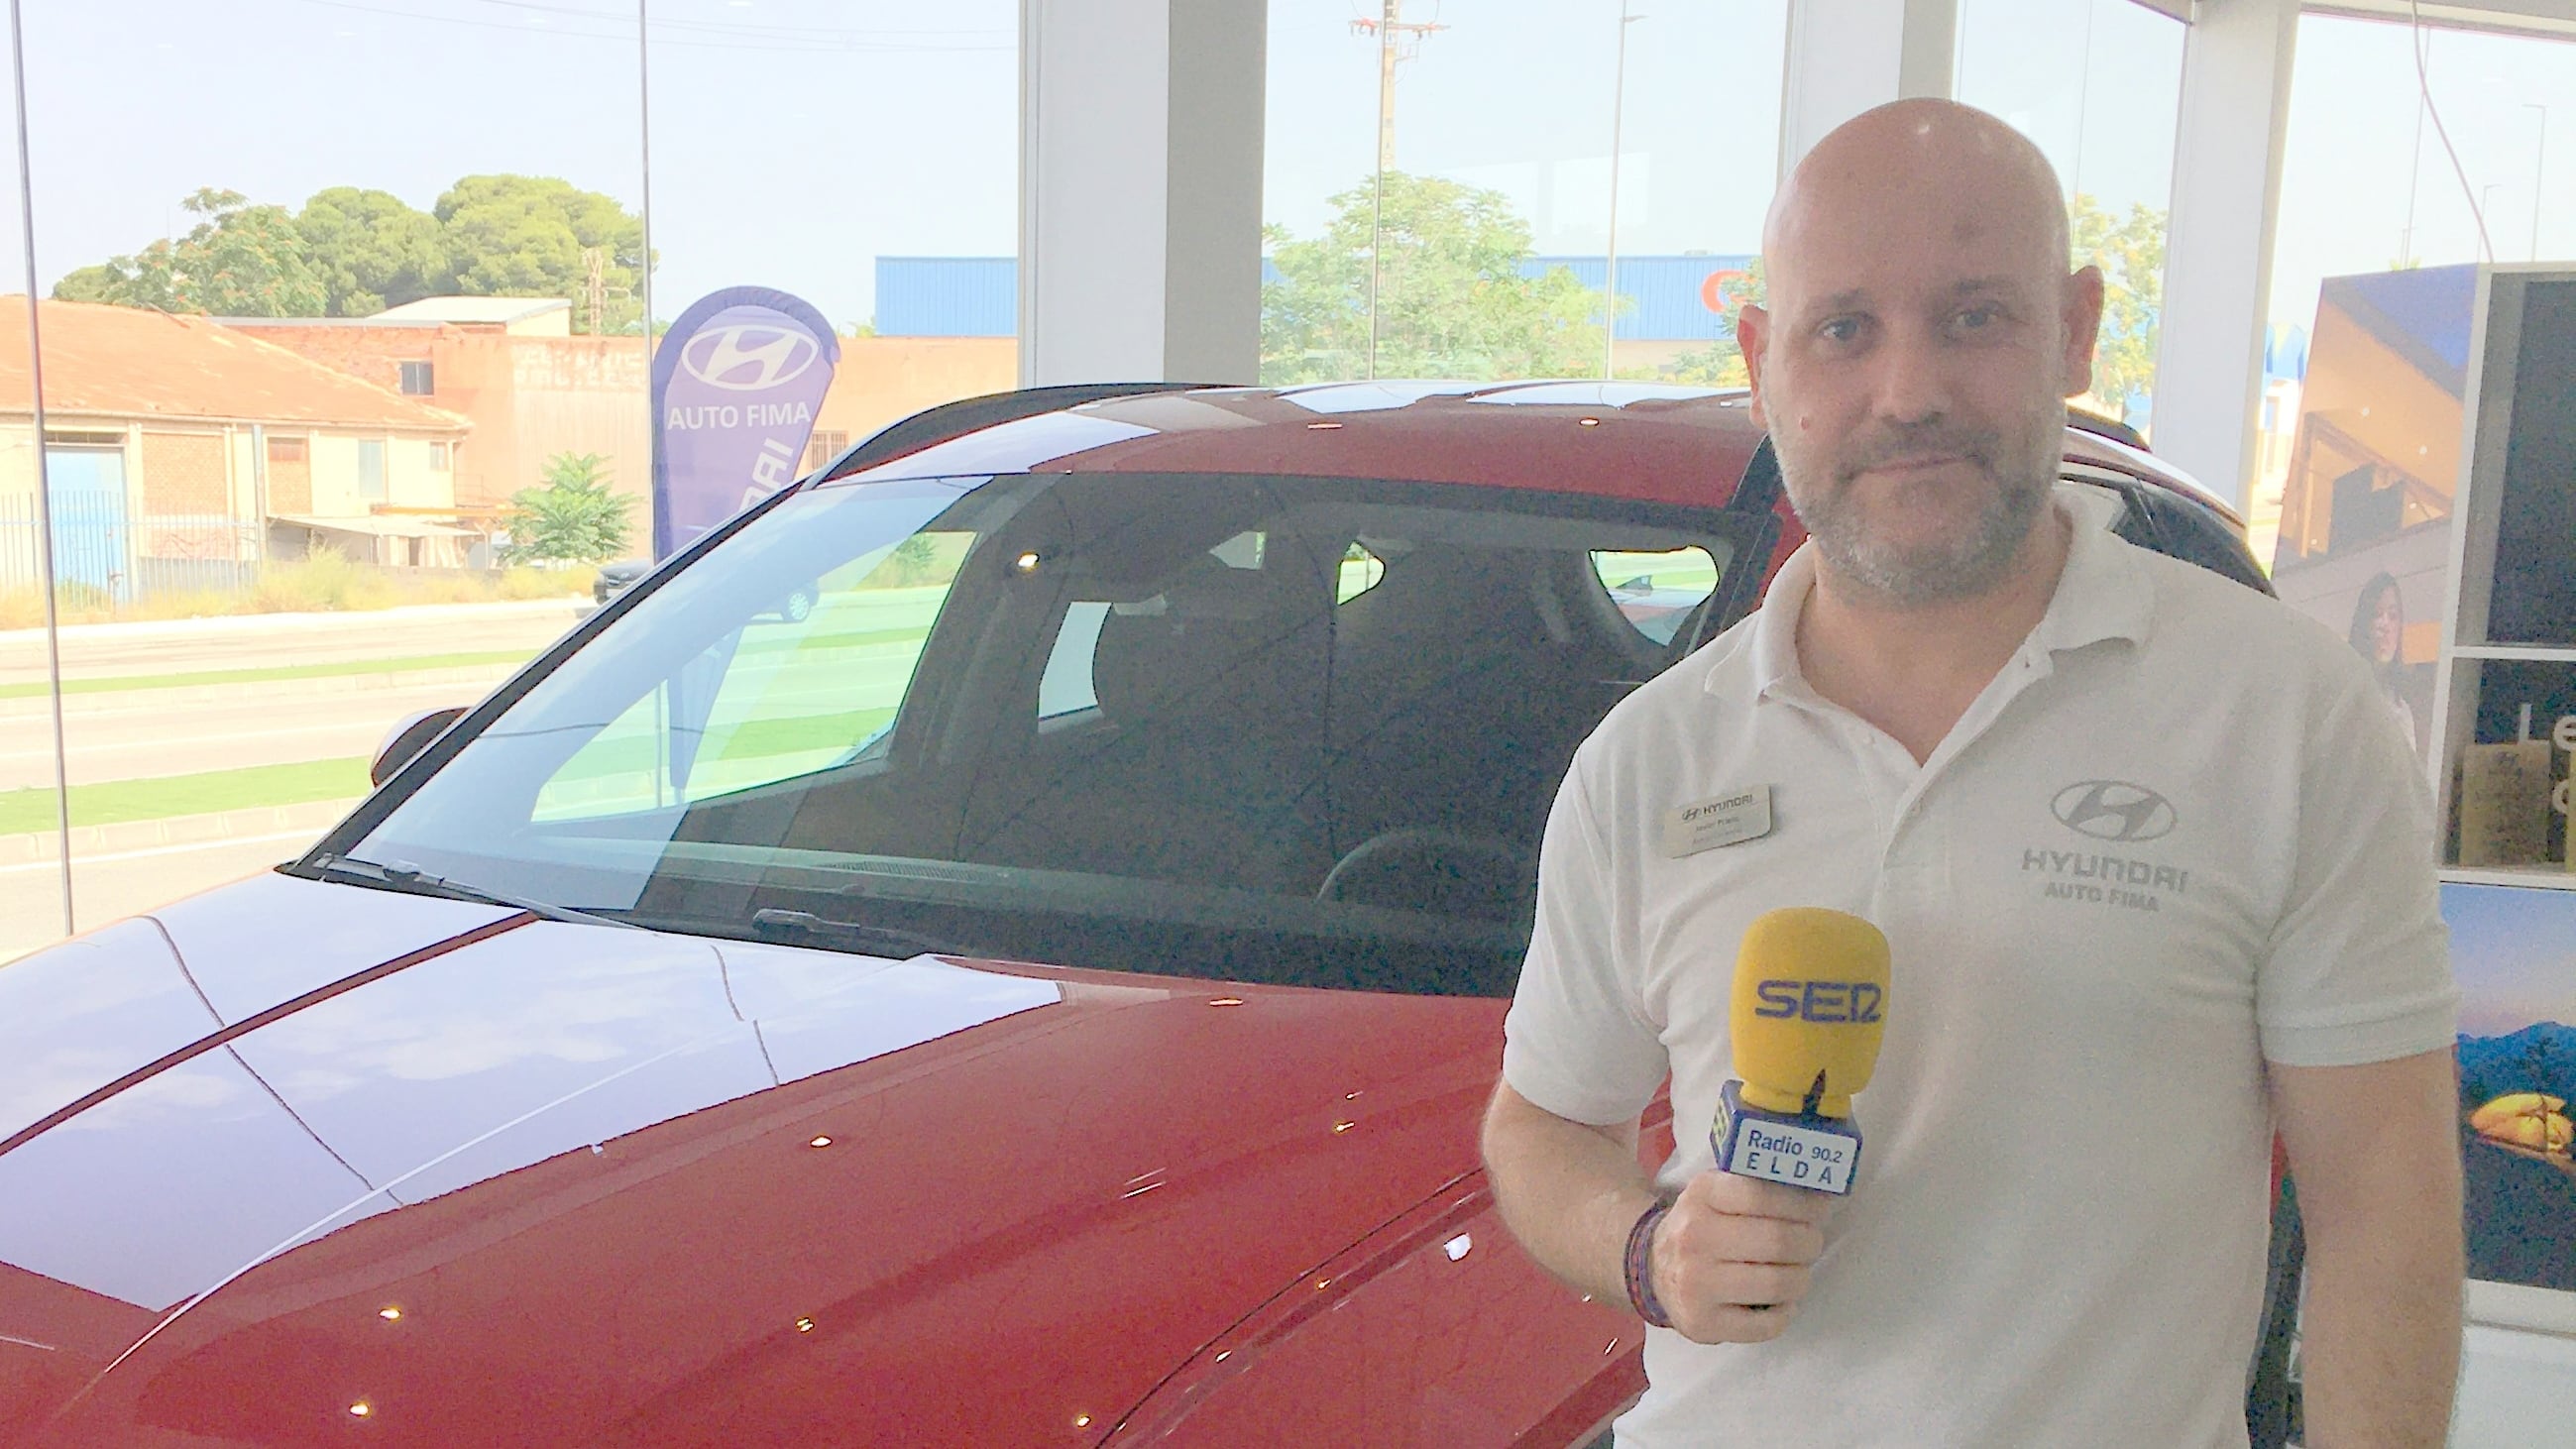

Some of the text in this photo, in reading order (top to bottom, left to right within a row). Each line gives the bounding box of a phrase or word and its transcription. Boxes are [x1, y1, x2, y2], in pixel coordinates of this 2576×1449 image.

[667, 401, 811, 430] AUTO FIMA
[1703, 794, 1753, 815] HYUNDAI
[2022, 848, 2188, 893] HYUNDAI
[2045, 881, 2160, 912] AUTO FIMA
[1754, 979, 1881, 1024] SER
[1747, 1130, 1843, 1164] Radio 90.2
[1746, 1152, 1833, 1184] ELDA
